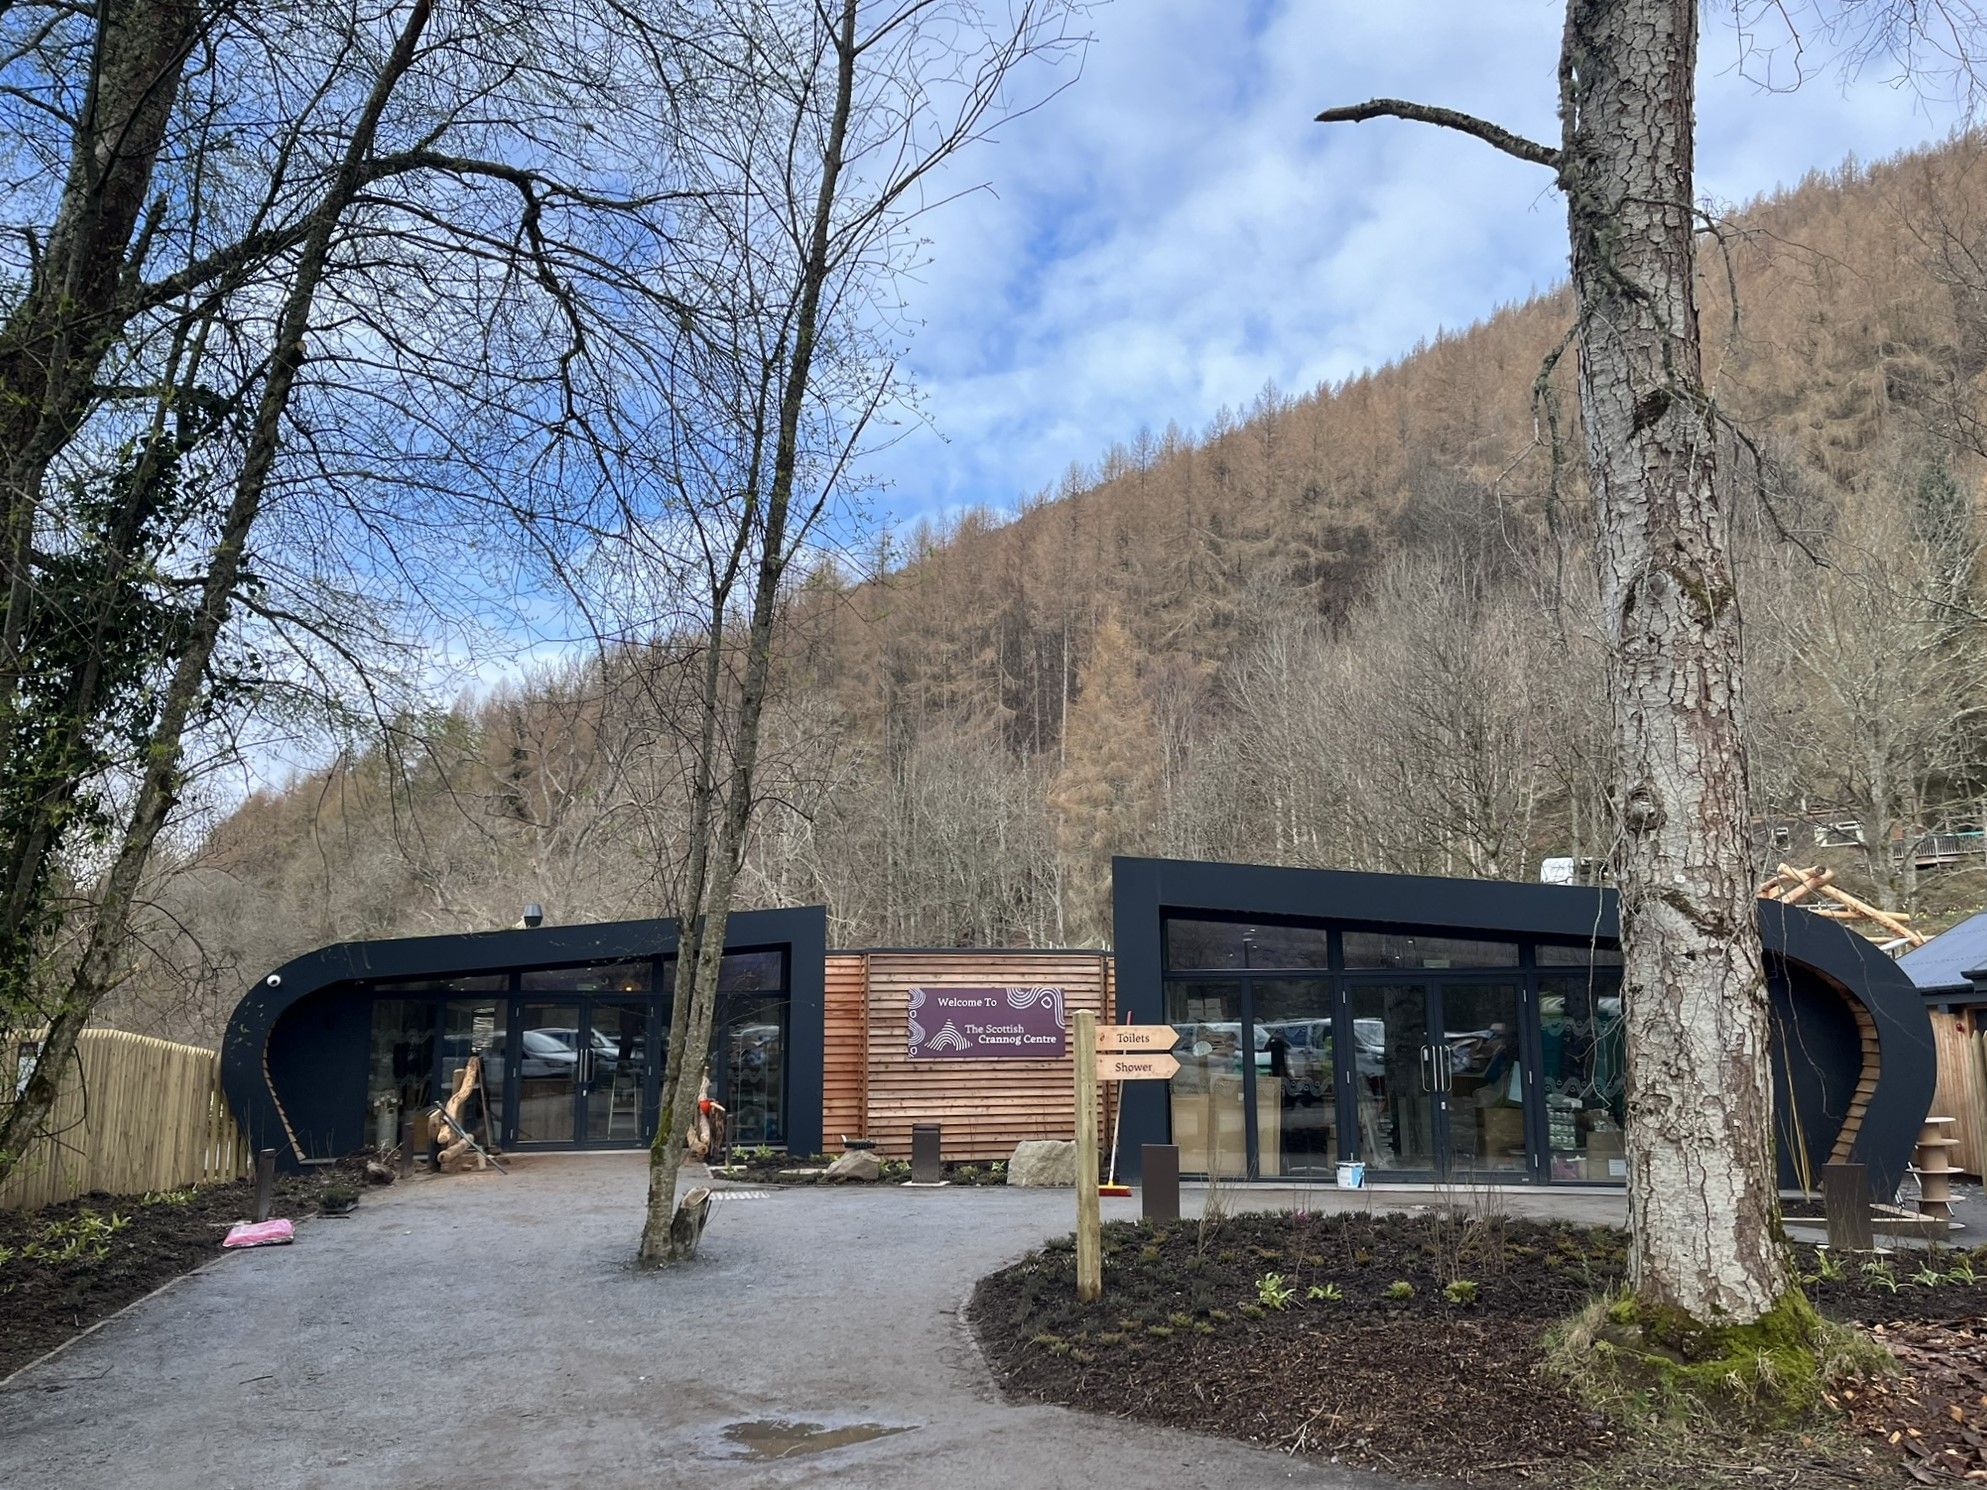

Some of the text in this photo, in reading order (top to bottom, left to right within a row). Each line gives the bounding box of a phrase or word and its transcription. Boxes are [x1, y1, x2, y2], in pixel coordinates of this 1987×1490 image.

[937, 997, 997, 1007] Welcome To
[964, 1024, 1025, 1034] The Scottish
[978, 1034, 1057, 1046] Crannog Centre
[1117, 1032, 1150, 1044] Toilets
[1115, 1061, 1153, 1073] Shower
